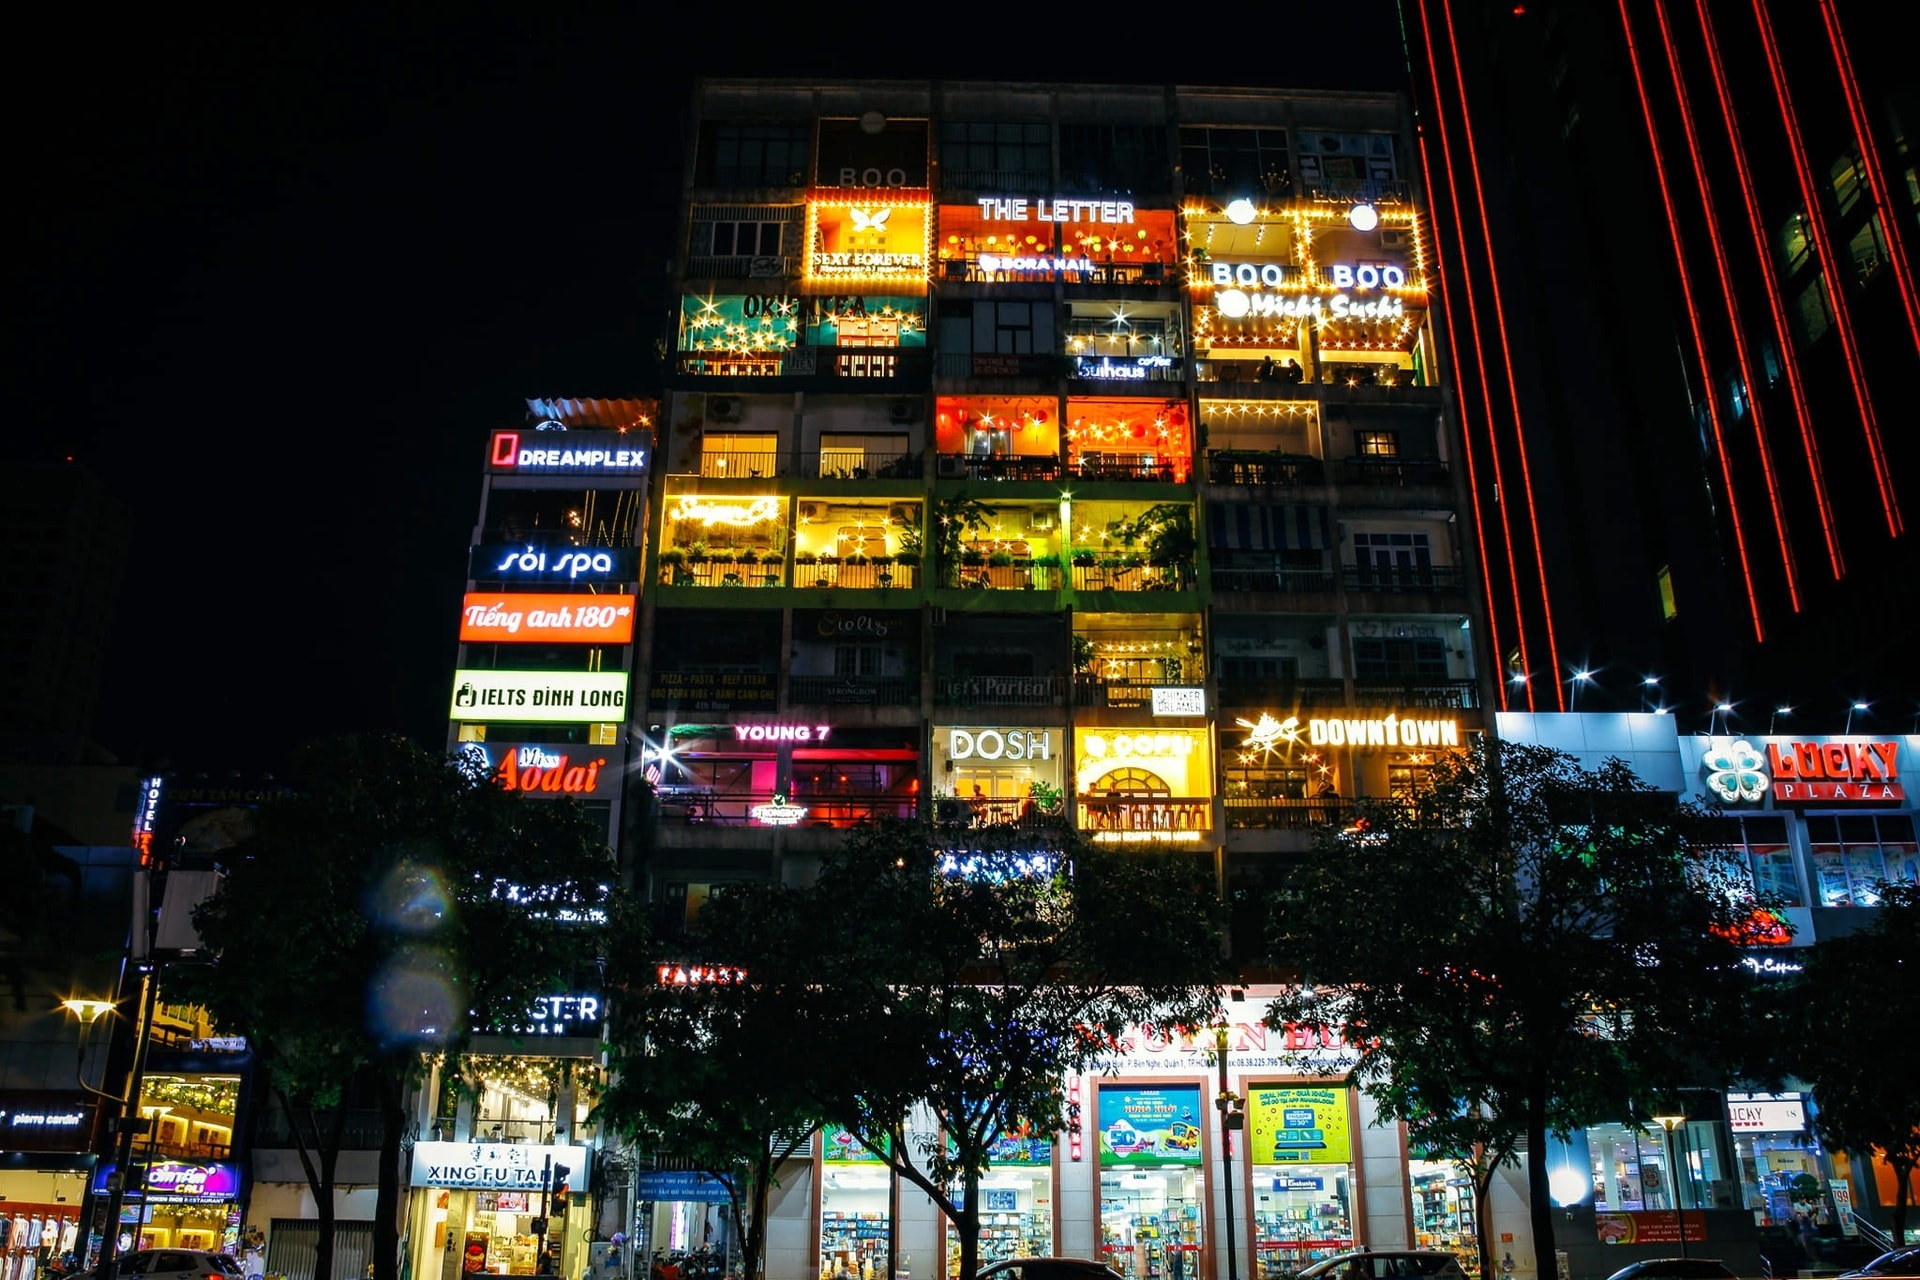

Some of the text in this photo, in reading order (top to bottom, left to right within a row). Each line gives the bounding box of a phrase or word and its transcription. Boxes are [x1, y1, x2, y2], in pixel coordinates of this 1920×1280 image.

[839, 168, 907, 187] BOO
[978, 199, 1134, 223] THE LETTER
[814, 253, 922, 265] SEXY FOREVER
[1053, 258, 1096, 271] NAIL
[1212, 263, 1283, 286] BOO
[1333, 265, 1405, 288] BOO
[1251, 293, 1403, 318] Michi Sushi
[518, 450, 645, 468] DREAMPLEX
[552, 552, 612, 579] spa
[527, 609, 571, 628] anh
[574, 606, 615, 628] 180
[481, 688, 526, 706] IELTS
[580, 690, 624, 707] LONG
[735, 725, 830, 740] YOUNG 7
[950, 729, 1049, 761] DOSH
[519, 747, 561, 768] Miss
[1767, 741, 1899, 781] LUCKY
[1784, 784, 1896, 798] PLAZA
[144, 777, 162, 831] HOTEL
[13, 1112, 79, 1126] pierre cardin
[429, 1166, 476, 1180] XING
[484, 1167, 508, 1181] FU
[175, 1184, 205, 1194] CALI
